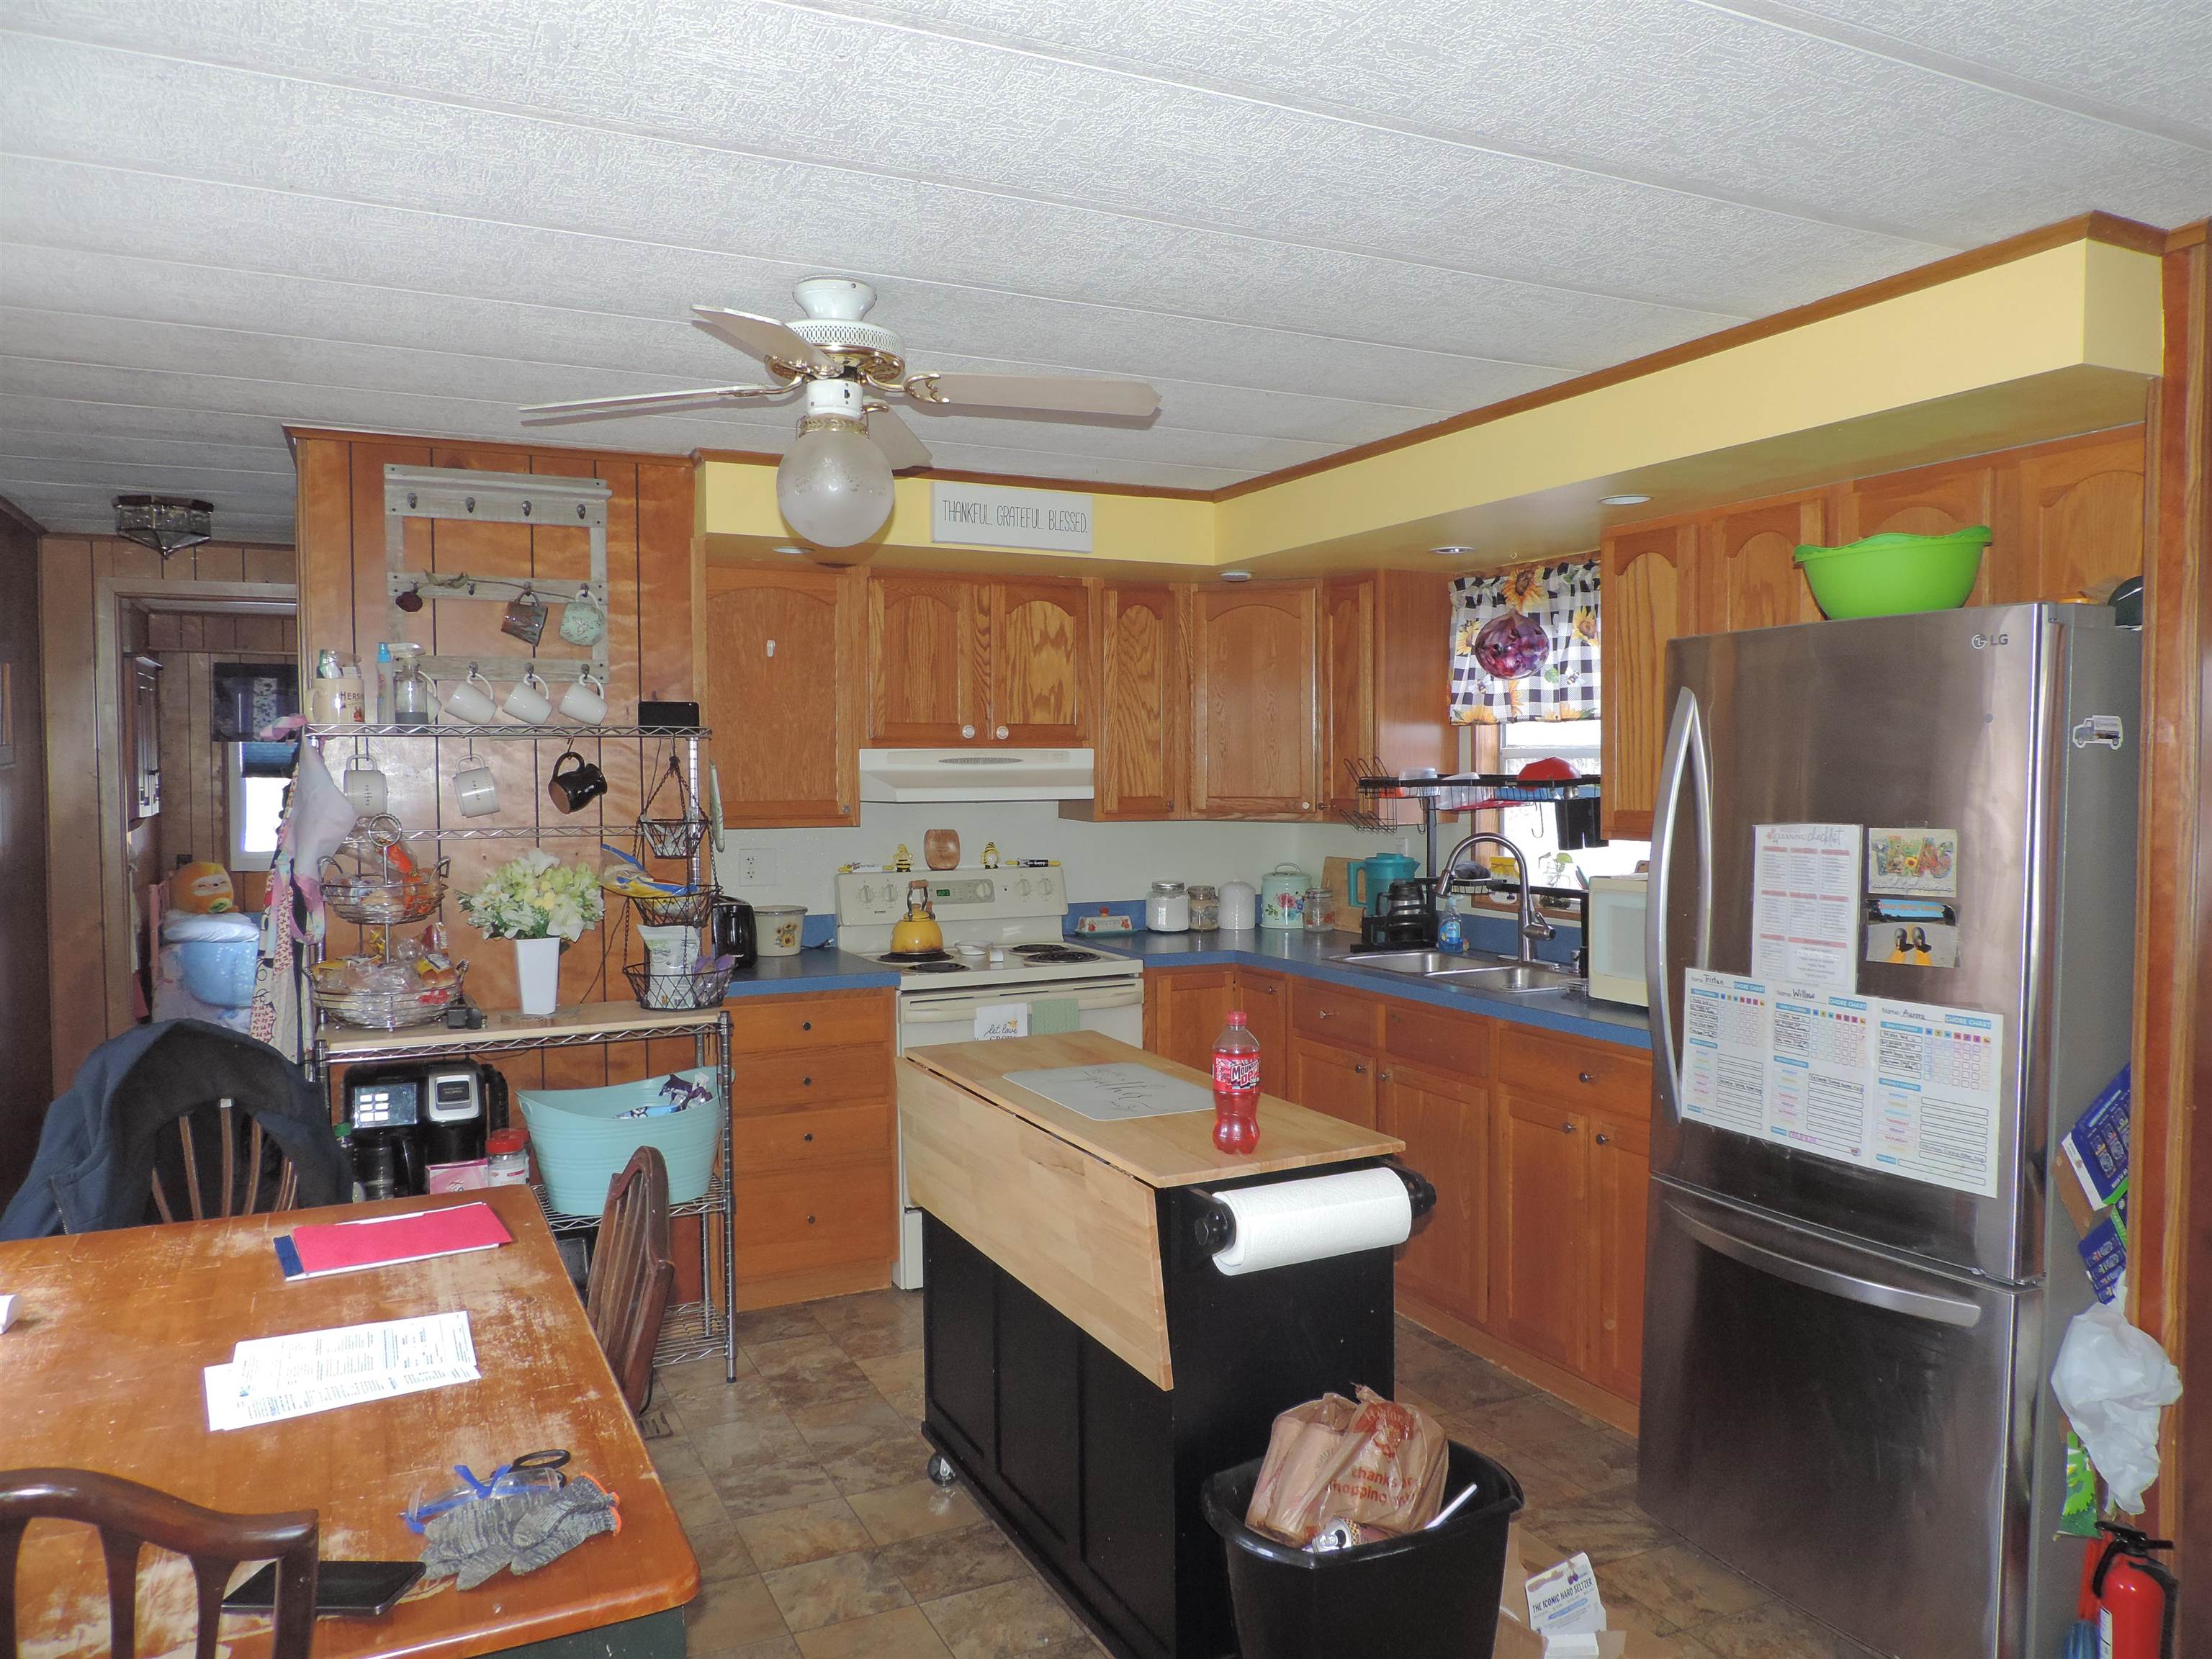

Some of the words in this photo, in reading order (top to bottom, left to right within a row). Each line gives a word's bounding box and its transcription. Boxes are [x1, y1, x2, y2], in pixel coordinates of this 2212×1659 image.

[943, 500, 993, 526] THANKFUL.
[997, 505, 1044, 530] GRATEFUL.
[1049, 510, 1088, 534] BLESSED.
[1990, 634, 2009, 646] LG
[1792, 987, 1815, 999] Willow
[1946, 1015, 1968, 1025] CHORE
[1969, 1019, 1991, 1030] CHART
[984, 1024, 1001, 1037] let
[1002, 1023, 1018, 1035] love
[1532, 1602, 1542, 1614] THE
[1542, 1593, 1560, 1609] ICONIC
[1560, 1587, 1573, 1601] HARD
[1574, 1578, 1593, 1594] SELTZER
